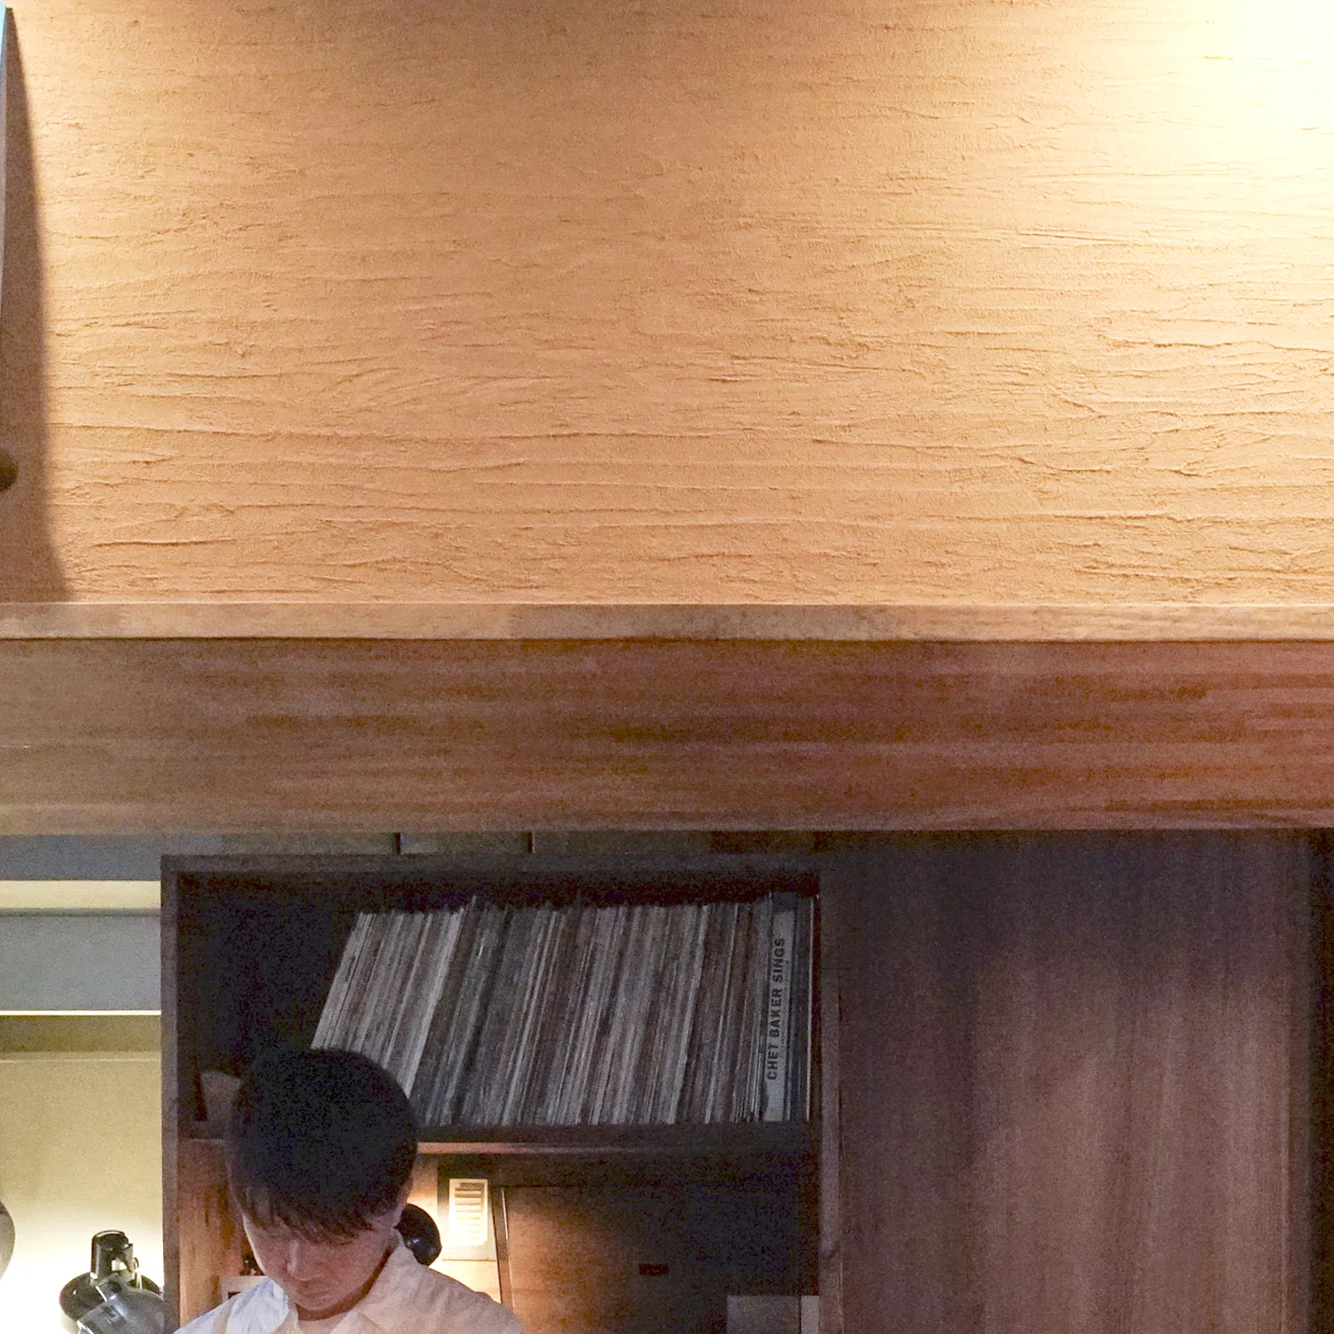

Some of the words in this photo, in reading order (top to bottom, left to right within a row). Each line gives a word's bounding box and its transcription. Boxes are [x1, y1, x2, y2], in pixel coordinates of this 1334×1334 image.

[773, 938, 785, 985] SINGS
[769, 988, 782, 1038] BAKER
[767, 1044, 780, 1080] CHET
